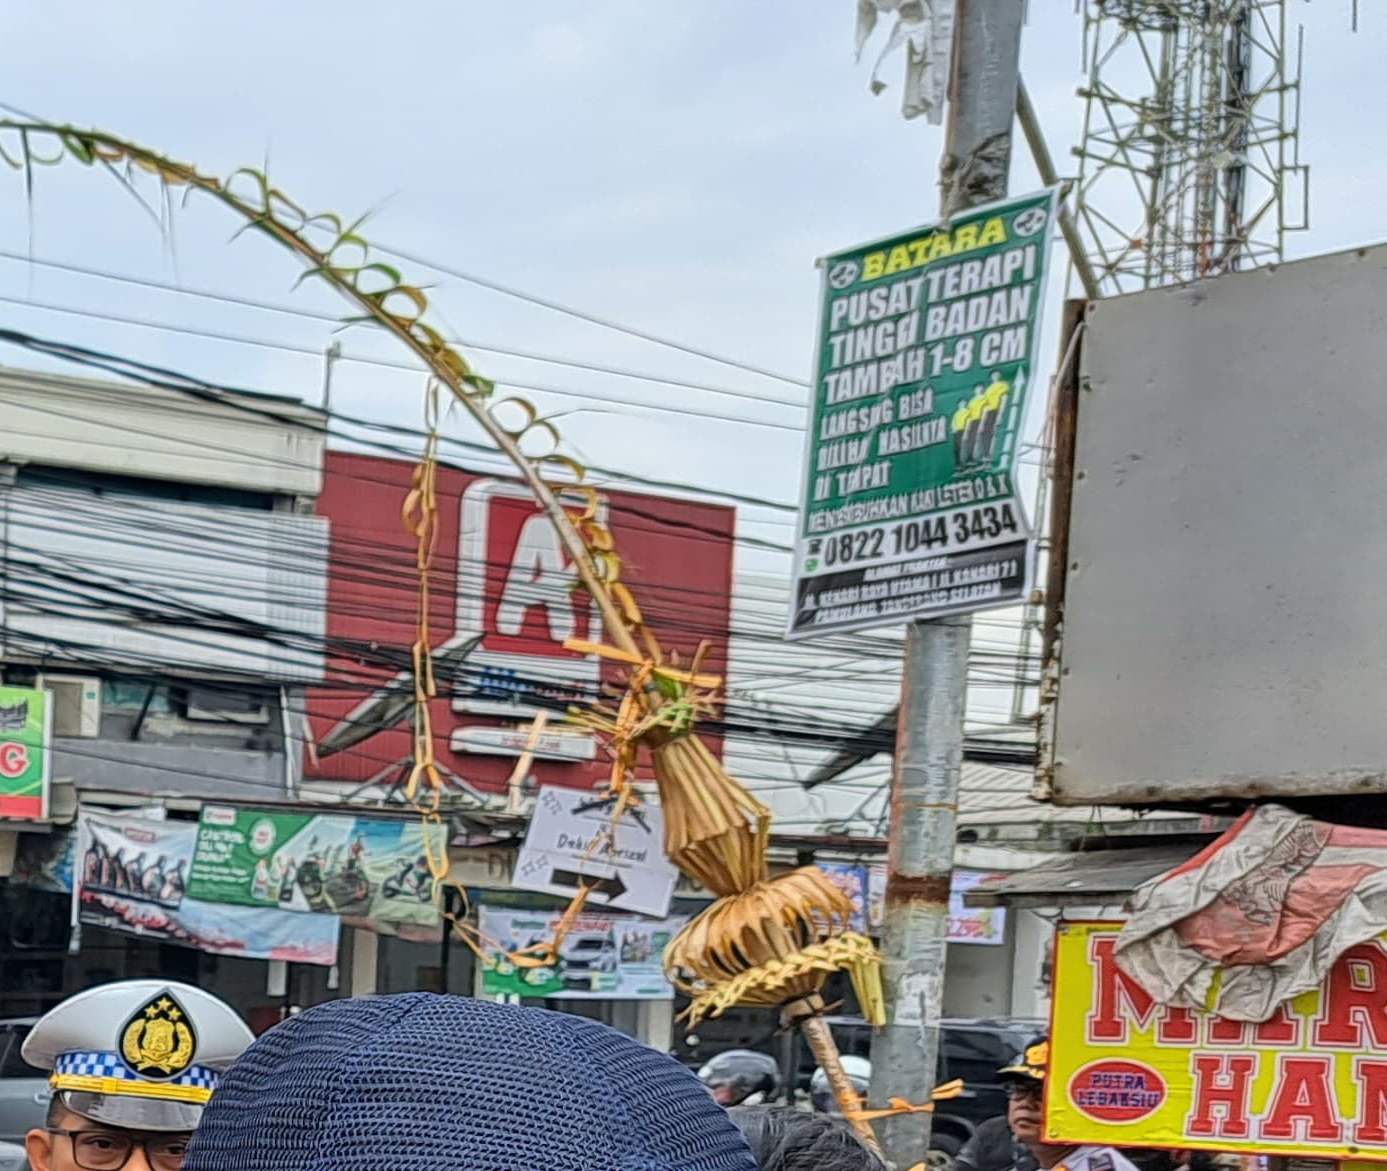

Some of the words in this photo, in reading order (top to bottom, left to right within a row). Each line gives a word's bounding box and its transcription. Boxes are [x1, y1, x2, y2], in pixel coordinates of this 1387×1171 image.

[861, 217, 1008, 281] BATARA
[829, 279, 924, 333] PUSAT
[926, 245, 1036, 296] TERAPI
[828, 312, 918, 369] TINGGI
[928, 283, 1032, 339] BADAN
[824, 347, 925, 405] TAMBAH
[930, 338, 973, 377] 1-8
[979, 323, 1026, 369] CM
[825, 529, 884, 567] 0822
[892, 516, 948, 555] 1044
[954, 503, 1018, 544] 3434
[1091, 1072, 1146, 1091] PUTRA
